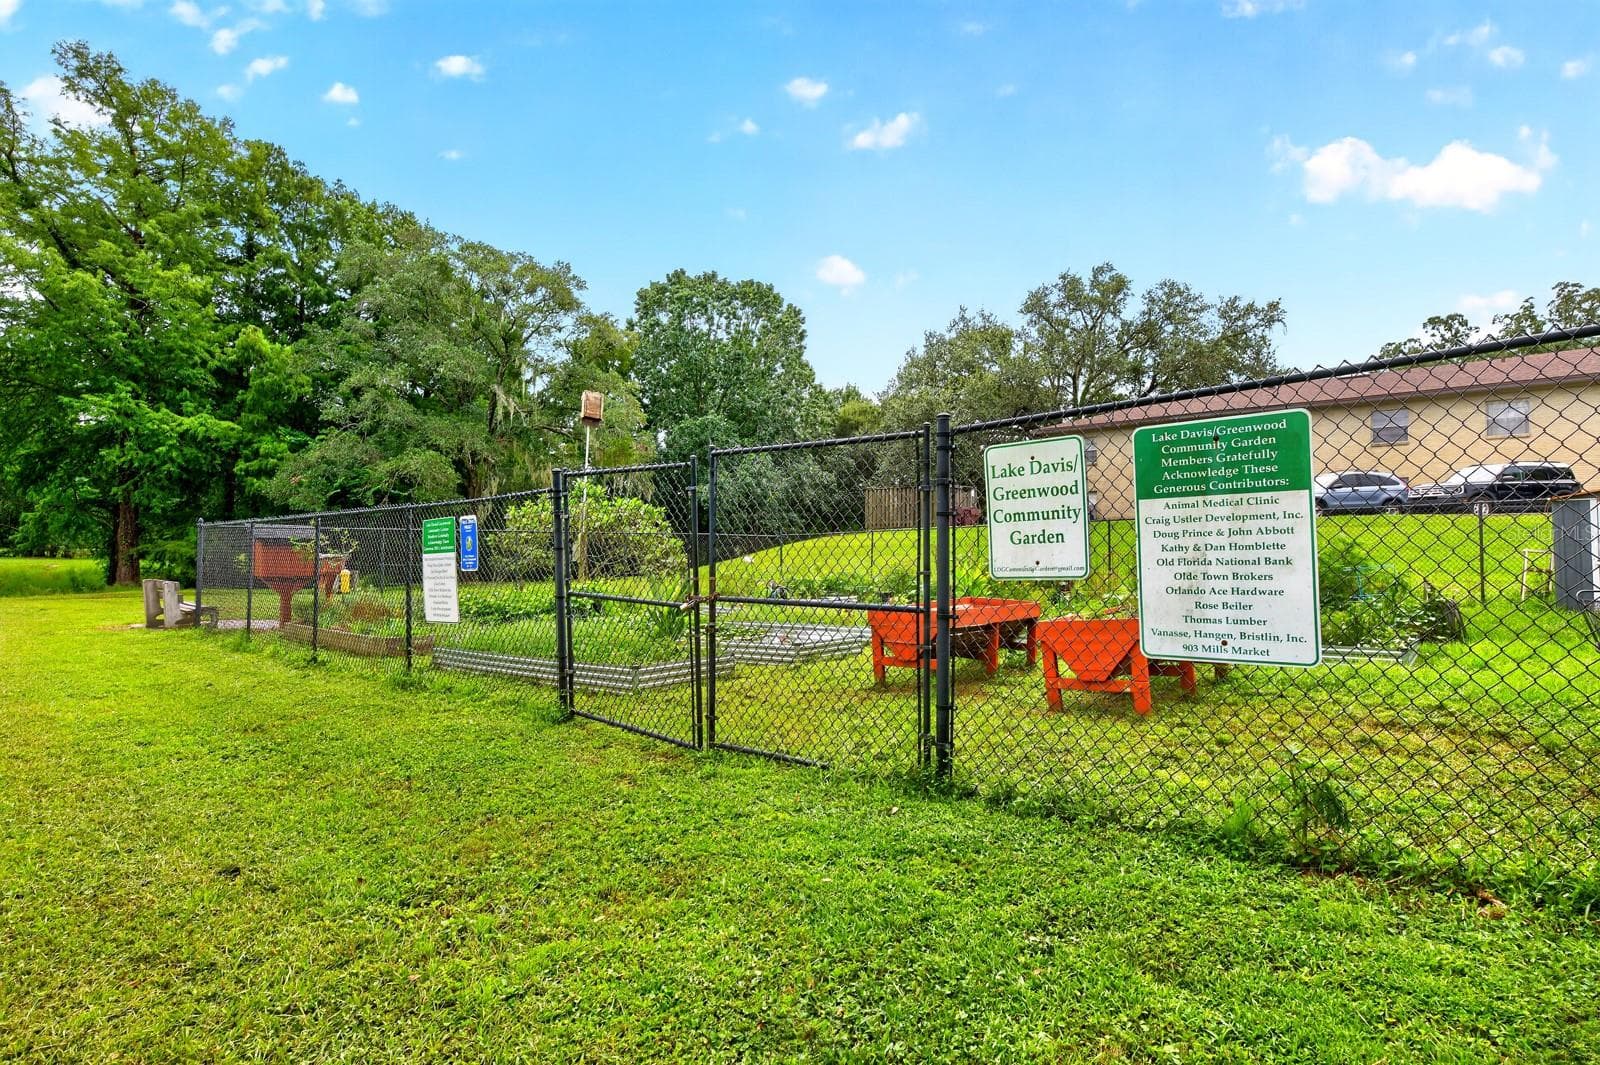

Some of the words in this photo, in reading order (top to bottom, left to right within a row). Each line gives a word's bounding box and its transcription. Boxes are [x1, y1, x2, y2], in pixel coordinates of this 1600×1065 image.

[1152, 432, 1177, 442] Lake
[1180, 419, 1287, 440] Davis/Greenwood
[1161, 442, 1227, 454] Community
[1231, 436, 1276, 448] Garden
[1161, 454, 1213, 467] Members
[1216, 449, 1278, 462] Gratefully
[991, 463, 1025, 479] Lake
[1029, 454, 1078, 475] Davis/
[1162, 466, 1239, 481] Acknowledge
[1242, 463, 1278, 474] These
[993, 480, 1079, 501] Greenwood
[1154, 482, 1206, 494] Generous
[1209, 478, 1289, 490] Contributors:
[1163, 499, 1199, 510] Animal
[1203, 498, 1243, 508] Medical
[1247, 496, 1279, 506] Clinic
[993, 505, 1081, 524] Community
[1145, 516, 1170, 526] Craig
[1173, 514, 1202, 524] Ustler
[1205, 512, 1279, 524] Development,
[1283, 511, 1304, 519] Inc.
[1010, 530, 1065, 545] Garden
[1153, 530, 1180, 539] Doug
[1182, 529, 1213, 537] Prince
[1216, 529, 1224, 537] &
[1227, 527, 1252, 538] John
[1256, 527, 1294, 535] Abbott
[1161, 545, 1189, 554] Kathy
[1192, 544, 1202, 552] &
[1204, 543, 1226, 552] Dan
[1229, 542, 1286, 551] Homblette
[1156, 558, 1174, 566] Old
[1178, 558, 1212, 566] Florida
[1216, 557, 1261, 566] National
[1265, 557, 1293, 566] Bank
[1174, 572, 1198, 581] Olde
[1200, 572, 1228, 581] Town
[1232, 572, 1274, 581] Brokers
[1166, 586, 1206, 595] Orlando
[1210, 587, 1228, 595] Ace
[1231, 587, 1284, 596] Hardware
[1194, 602, 1219, 610] Rose
[1222, 602, 1253, 611] Beiler
[1182, 615, 1222, 625] Thomas
[1226, 617, 1268, 626] Lumber
[1151, 628, 1191, 638] Vanasse,
[1194, 630, 1236, 641] Hangen,
[1240, 632, 1283, 643] Bristlin,
[1287, 634, 1307, 643] Inc.
[1182, 644, 1198, 652] 903
[1202, 645, 1228, 654] Mills
[1231, 646, 1270, 656] Market
